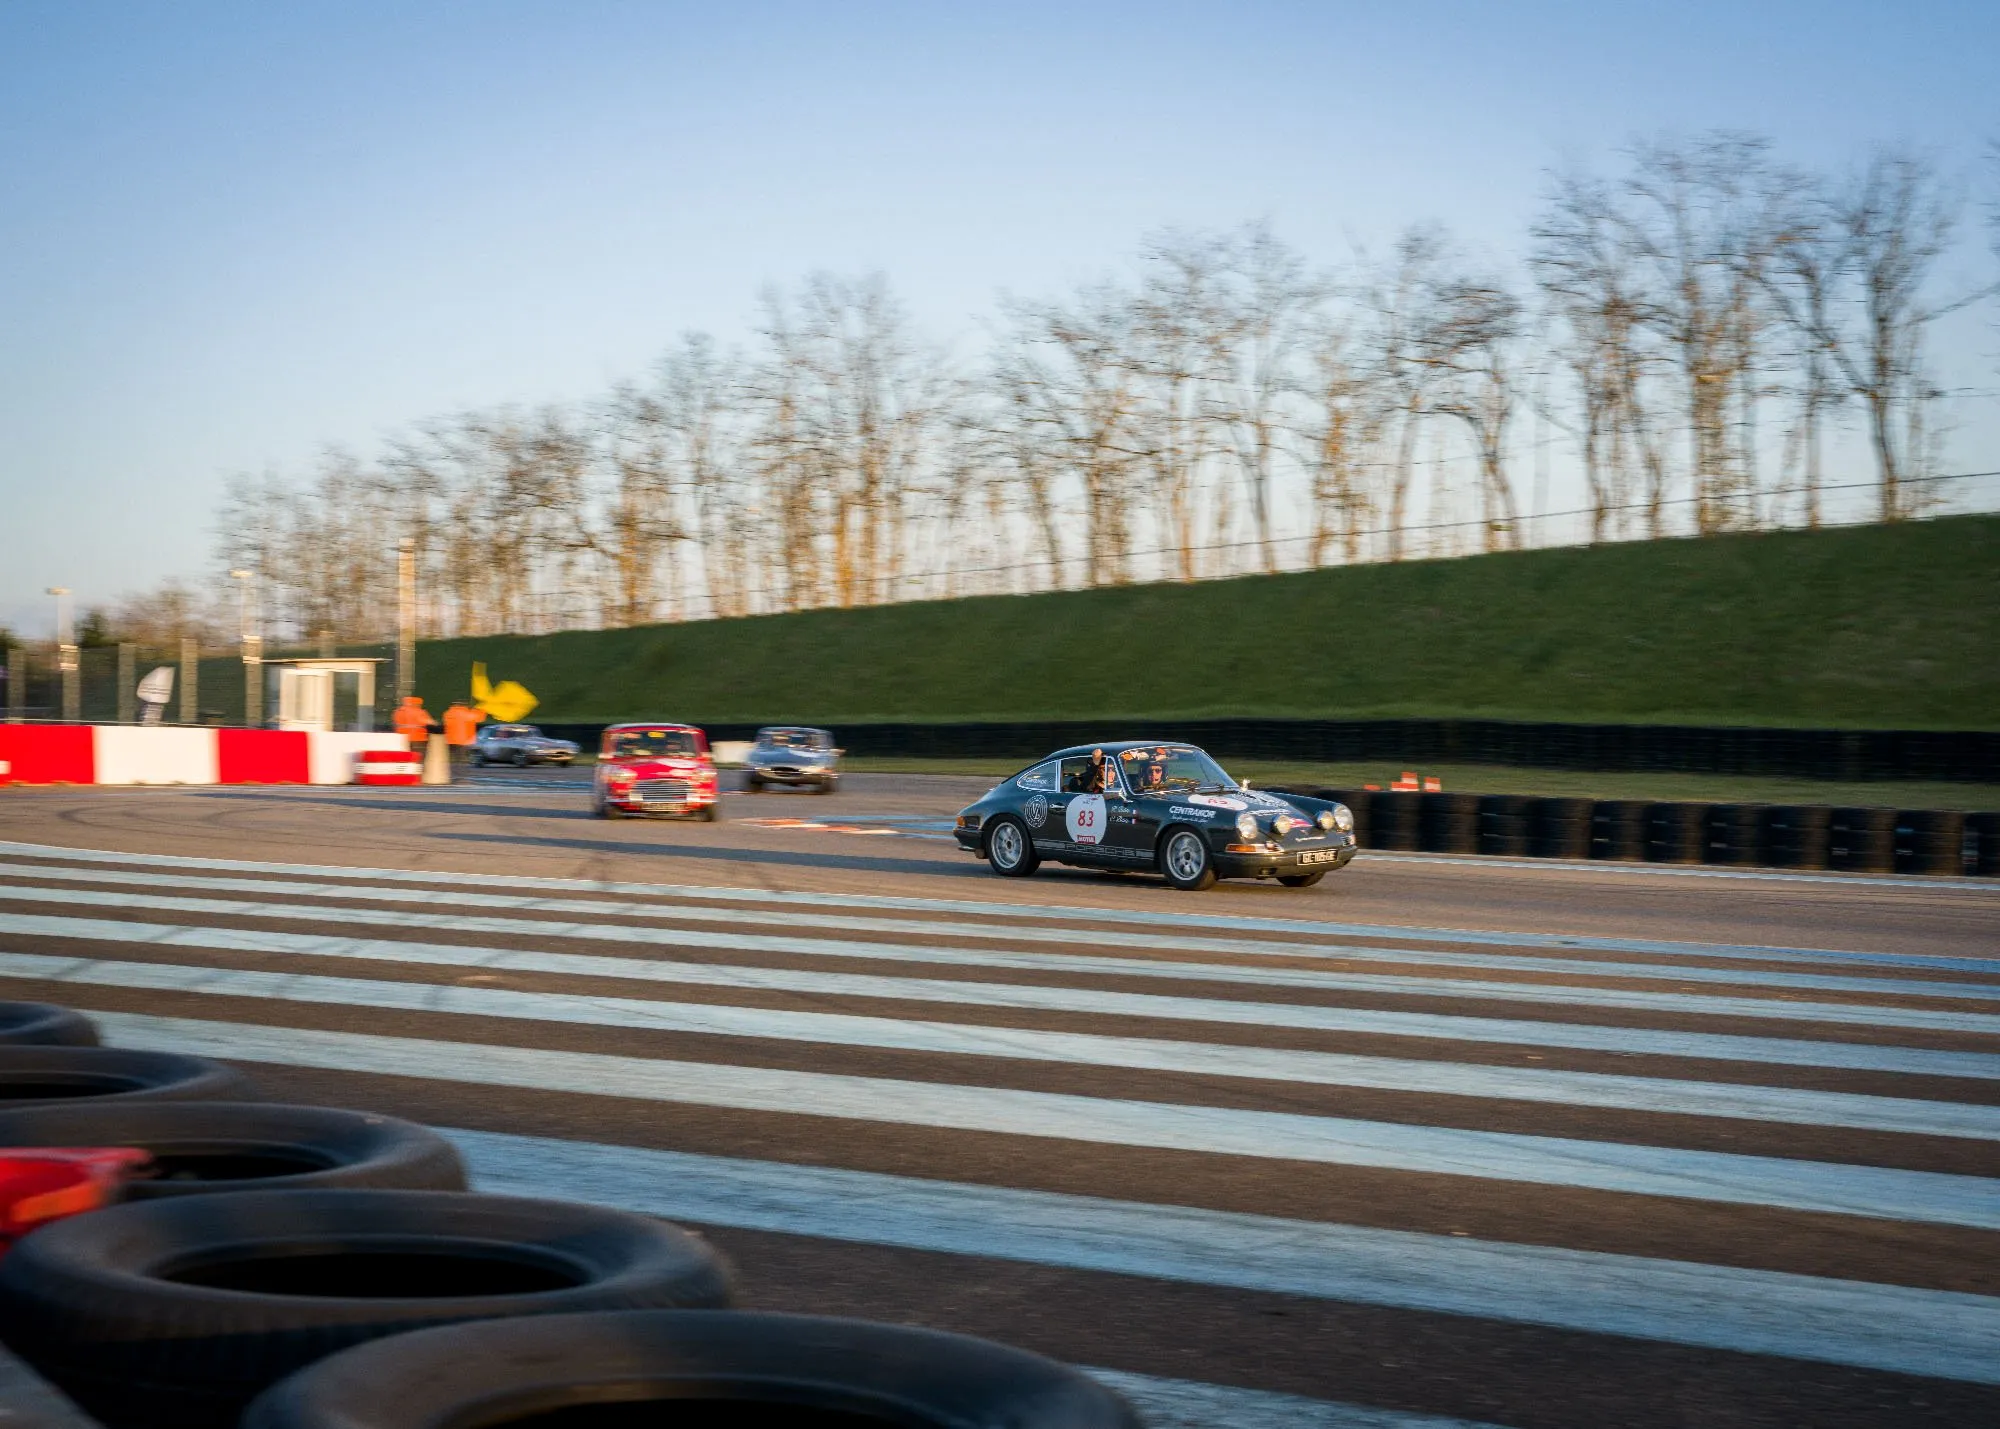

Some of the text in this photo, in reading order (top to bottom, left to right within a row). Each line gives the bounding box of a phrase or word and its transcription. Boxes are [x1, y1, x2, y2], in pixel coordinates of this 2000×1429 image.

[1169, 805, 1216, 818] CENTRAKOR
[1078, 810, 1094, 827] 83
[1066, 844, 1135, 856] PORSCHE
